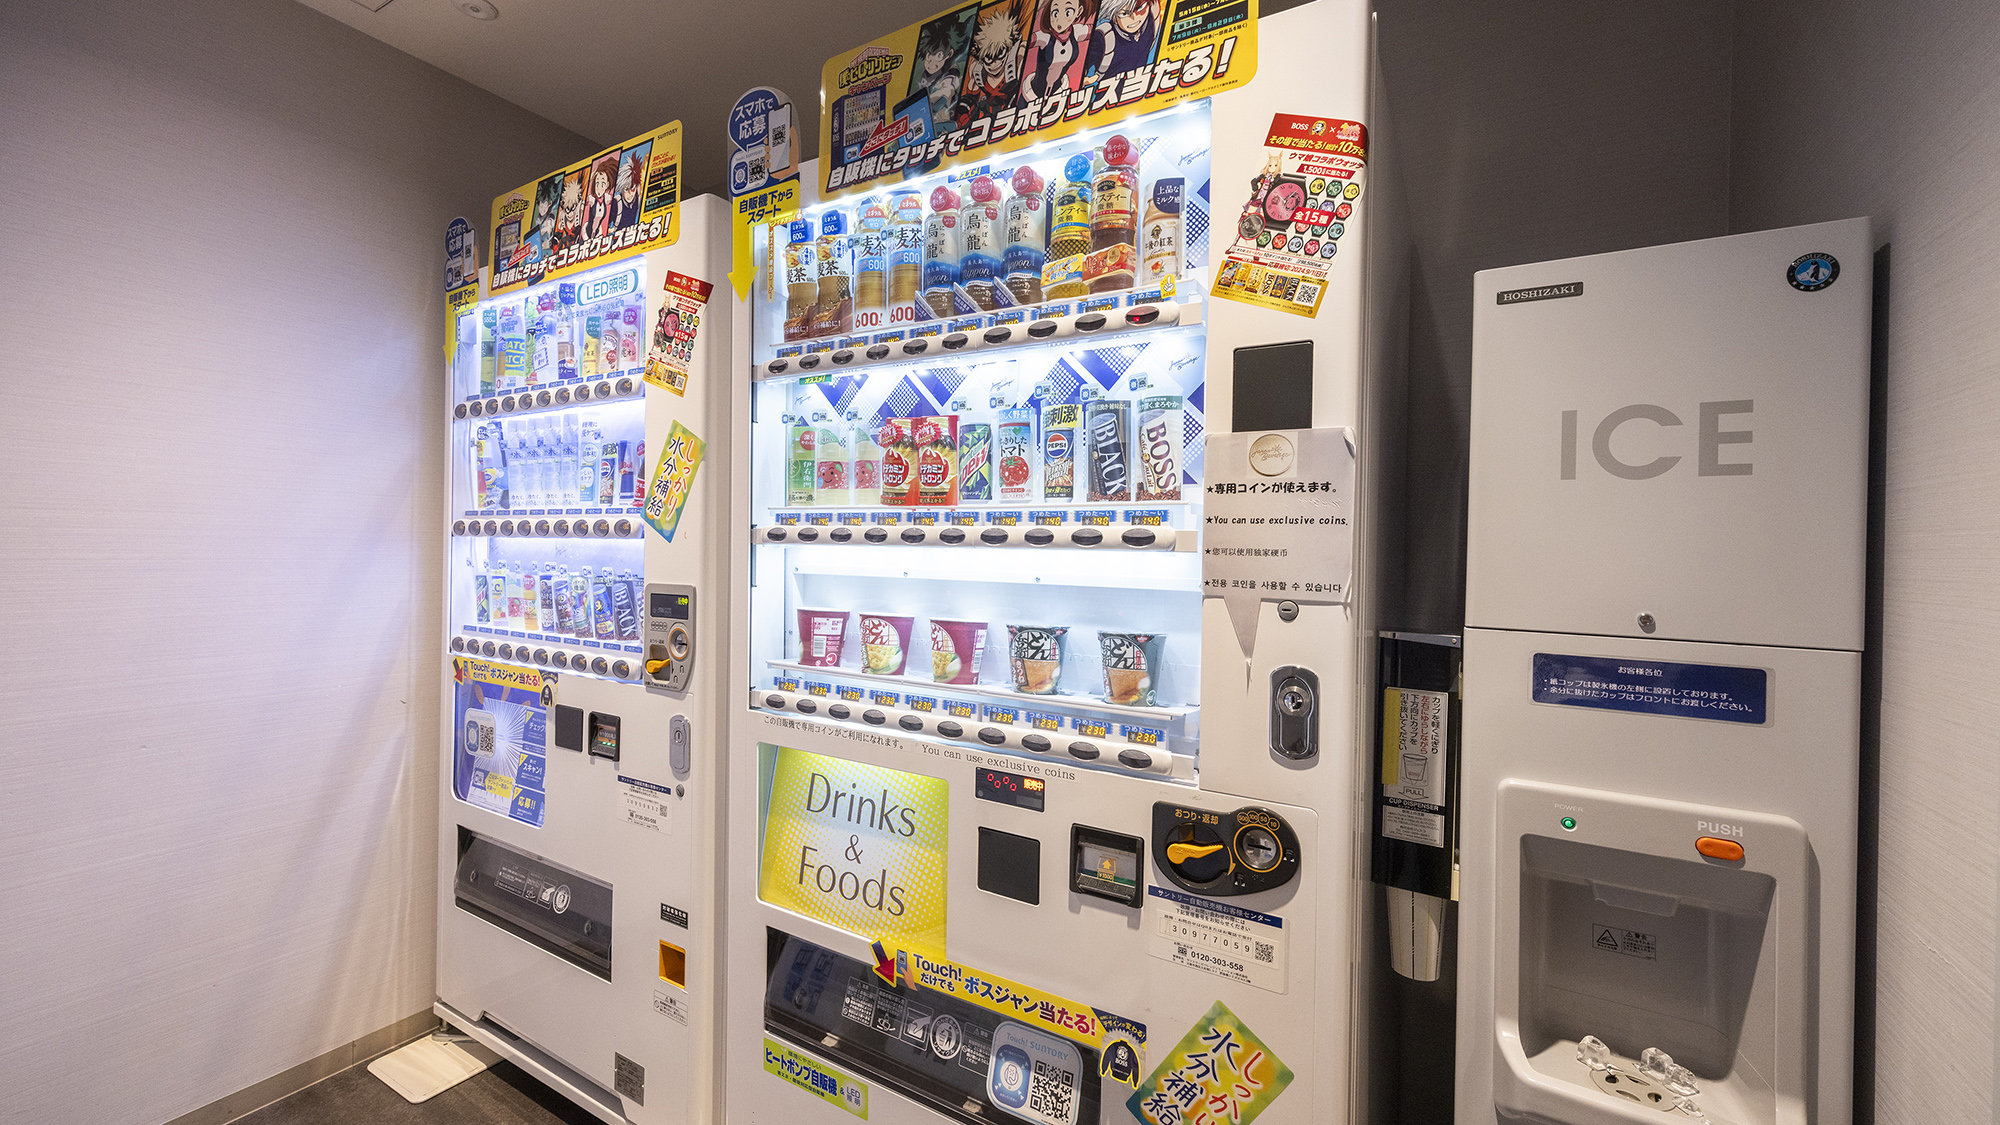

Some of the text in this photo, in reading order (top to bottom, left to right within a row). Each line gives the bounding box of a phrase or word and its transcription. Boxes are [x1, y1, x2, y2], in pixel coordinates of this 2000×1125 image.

[848, 73, 892, 96] キャンペーン
[735, 97, 774, 122] スマホで
[657, 128, 678, 141] SUNTORY
[738, 116, 767, 141] 応募
[1291, 122, 1309, 131] BOSS
[739, 188, 794, 213] 自販機下から
[746, 205, 782, 225] スタート
[1293, 209, 1330, 225] 全15種
[862, 235, 887, 257] 麦茶
[896, 228, 923, 250] 麦茶
[868, 260, 885, 271] 600
[903, 252, 920, 263] 600
[1792, 252, 1836, 268] HOSHIZAKI
[586, 274, 628, 301] LED照明
[1503, 283, 1576, 302] HOSHIZAKI
[890, 306, 914, 324] 600
[1560, 399, 1754, 481] ICE
[1094, 420, 1127, 495] BLACK
[1146, 421, 1177, 489] BOSS
[647, 435, 685, 518] 水分補給
[666, 438, 694, 519] しっかり
[1214, 481, 1337, 495] 専用コインが使えます。
[1213, 515, 1349, 526] You can use exclusive coins.
[1212, 547, 1288, 558] 您可以使用独家硬币
[1211, 578, 1342, 594] 전용 코인을 사용할 수 있습니다
[614, 587, 635, 637] BLACK
[470, 660, 490, 673] Touch!
[490, 667, 541, 687] ボスジャン当たる!
[1617, 665, 1664, 678] お客様各位
[763, 716, 904, 750] この自販機で専用コインがご利用になれます。
[921, 743, 1076, 781] You can use exclusive coins
[1405, 788, 1422, 797] PULL
[805, 771, 916, 838] Drinks
[1403, 799, 1440, 812] DISPENSER
[1553, 802, 1585, 813] POWER
[1174, 808, 1219, 825] おつり・返却
[1697, 820, 1744, 838] PUSH
[844, 833, 864, 865] &
[797, 844, 906, 917] Foods
[1158, 889, 1272, 923] サントリー自動販売機お客様センター
[912, 953, 963, 982] Touch!
[1190, 950, 1244, 972] 0120-303-558
[919, 972, 956, 993] だけでも
[964, 975, 1096, 1037] ボスジャン当たる!
[1006, 1032, 1028, 1047] Touch!
[1029, 1040, 1070, 1061] SUNTORY
[765, 1047, 837, 1097] ヒートポンプ自販機
[1143, 1027, 1241, 1125] 水分補給
[846, 1086, 861, 1099] LED
